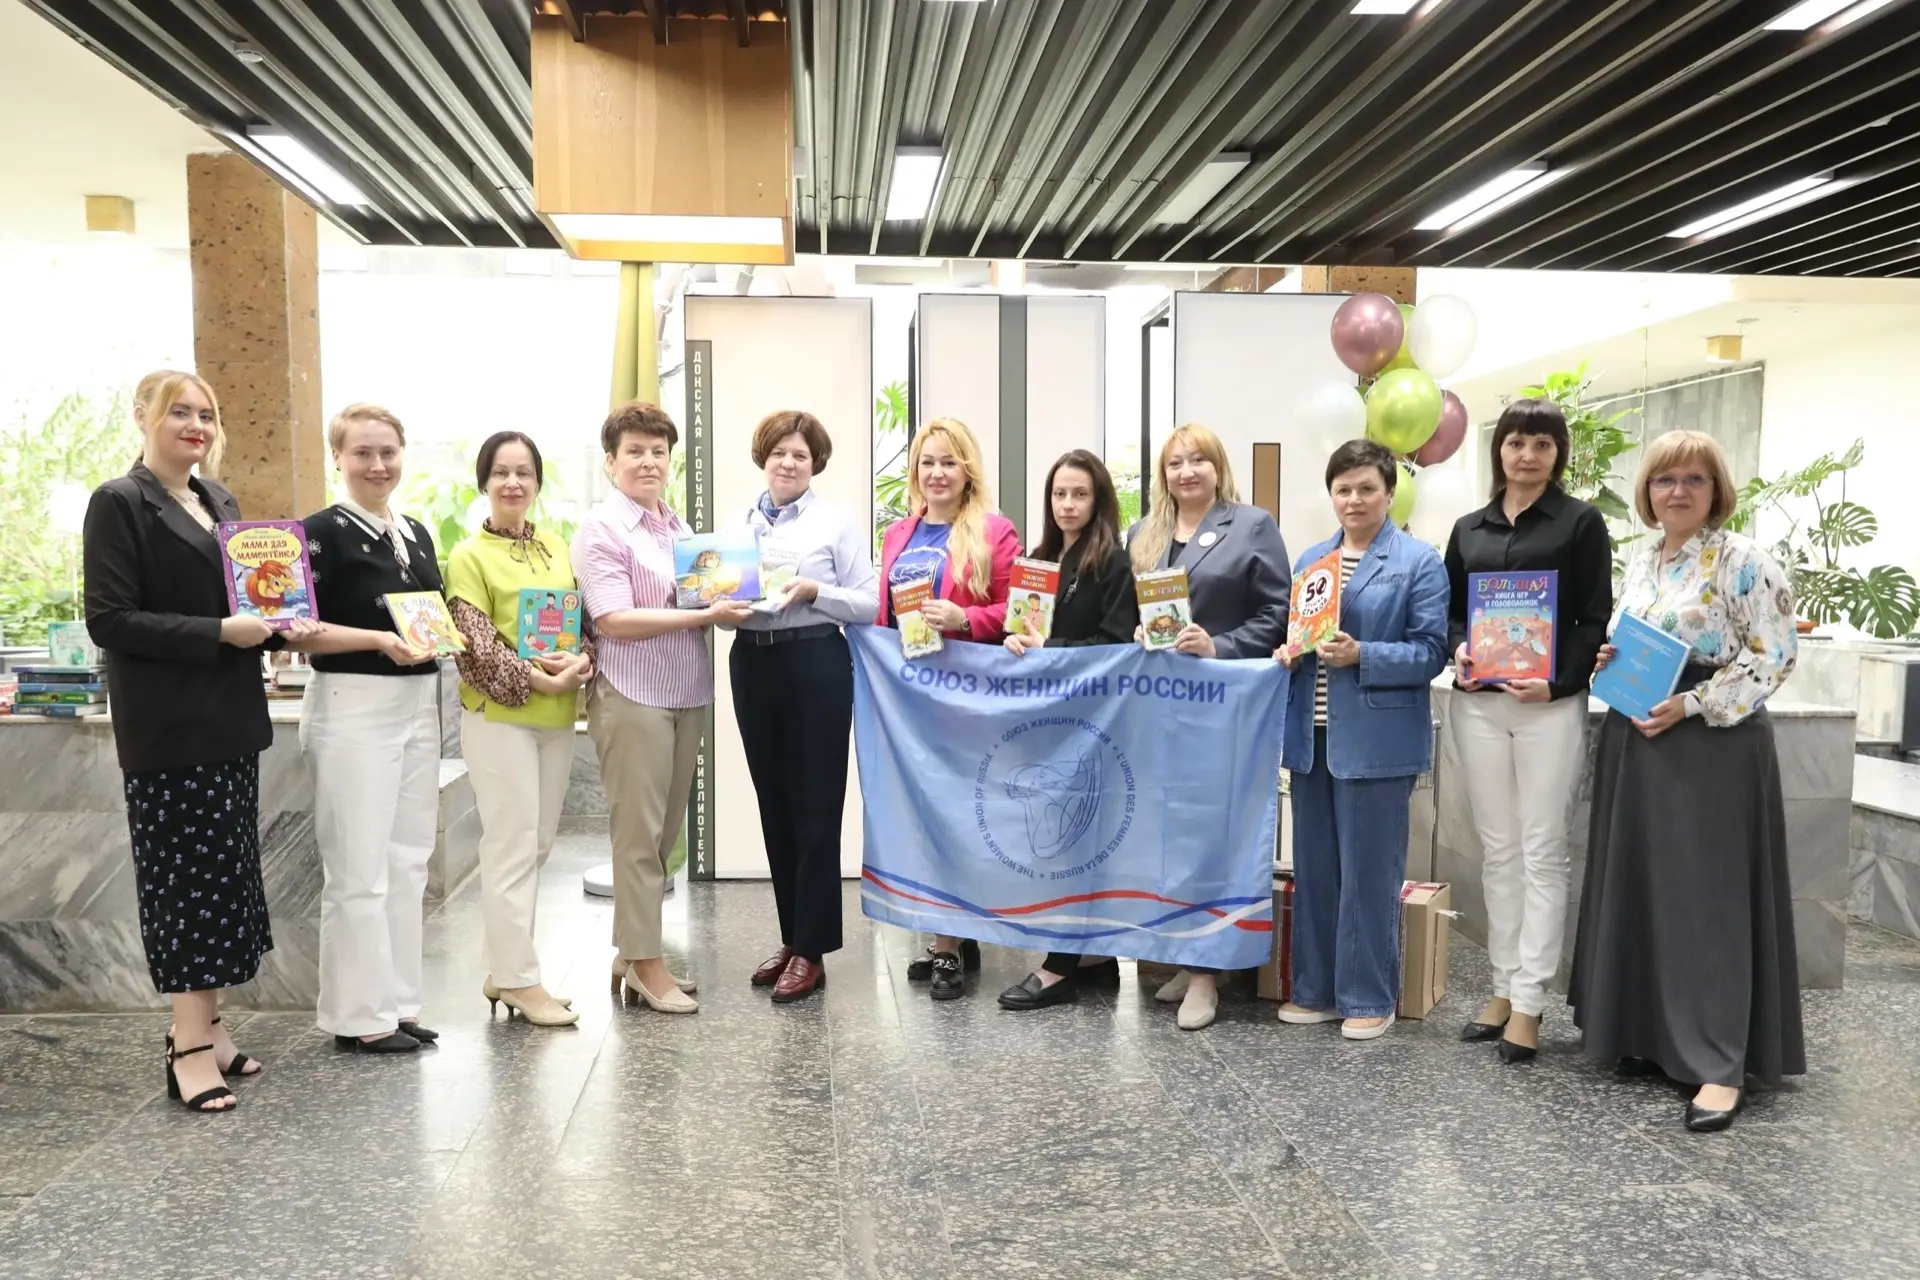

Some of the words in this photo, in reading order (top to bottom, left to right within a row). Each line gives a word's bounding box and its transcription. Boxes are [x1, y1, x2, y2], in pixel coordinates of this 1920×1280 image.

[693, 351, 702, 438] ДОНСКАЯ
[694, 446, 704, 532] ГОСУДАР
[241, 541, 268, 549] МАМА
[270, 540, 287, 549] ДЛЯ
[236, 550, 296, 560] МАМОНТЁНКА
[1305, 576, 1327, 603] 50
[1477, 576, 1548, 592] БОЛЬШАЯ
[1491, 599, 1539, 607] ГОЛОВОЛОМОК
[1494, 592, 1516, 600] КНИГА
[1516, 591, 1529, 599] ИГР
[1302, 597, 1328, 616] СТИХОВ
[899, 663, 978, 694] СОЮЗ
[984, 675, 1108, 701] ЖЕНЩИН
[1117, 674, 1226, 704] РОССИИ
[1001, 722, 1029, 743] СОЮЗ
[1029, 716, 1076, 729] ЖЕНЩИН
[1077, 718, 1112, 745] РОССИИ
[976, 753, 994, 785] RUSSIA
[1116, 752, 1136, 792] L'UNION
[975, 786, 984, 799] OF
[1126, 794, 1136, 813] DES
[697, 754, 705, 874] БИБЛИОТЕКА
[975, 802, 988, 832] UNION
[1106, 814, 1133, 853] FEMMES
[983, 832, 1018, 873] WOMEN'S
[1095, 850, 1109, 865] DE
[1015, 864, 1034, 879] THE
[1049, 864, 1085, 880] RUSSIE
[1085, 859, 1096, 871] LA
